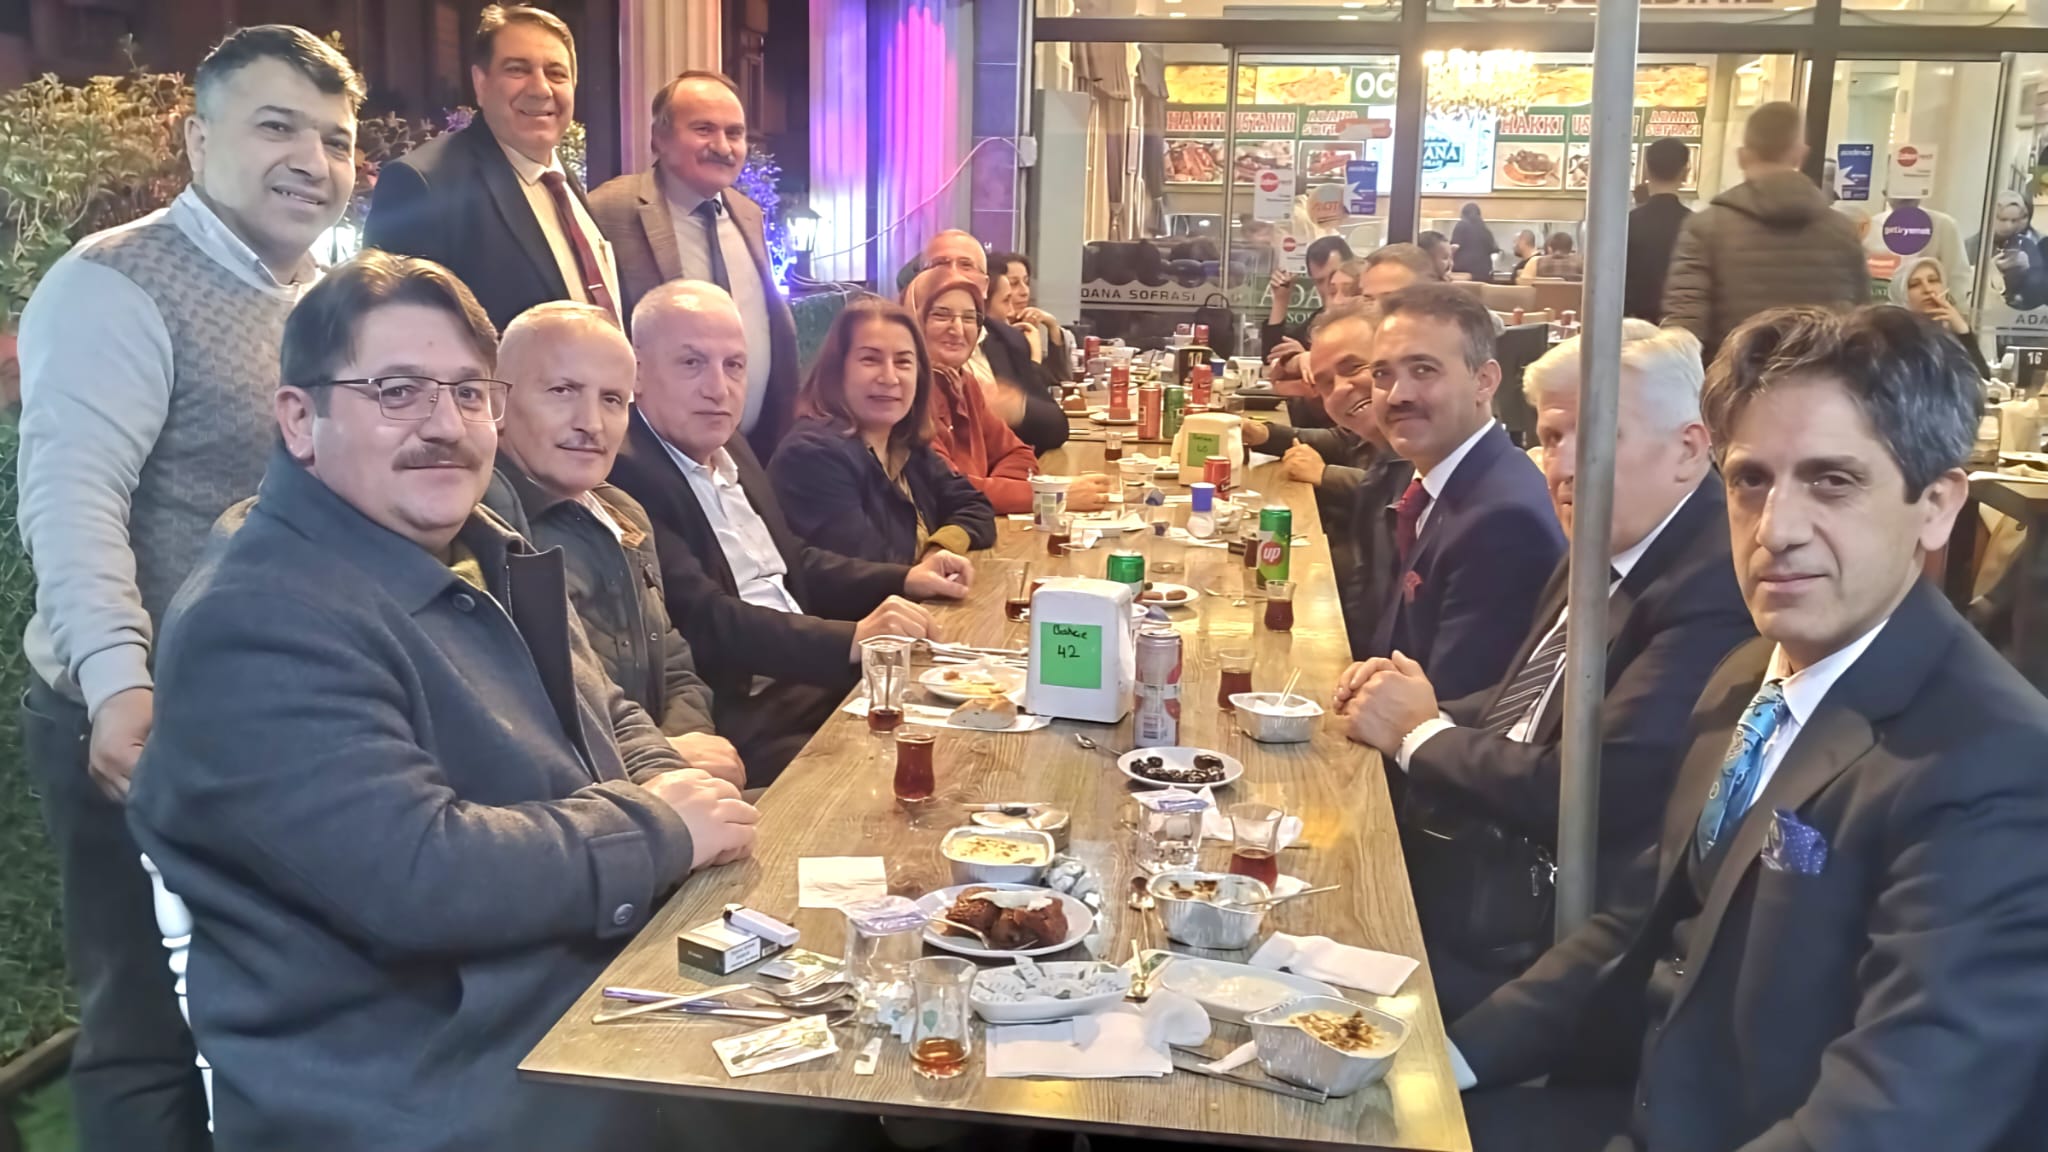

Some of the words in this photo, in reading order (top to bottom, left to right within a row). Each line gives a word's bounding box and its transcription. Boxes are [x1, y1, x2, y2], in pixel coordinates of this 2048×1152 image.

[1650, 110, 1699, 123] ADANA
[1500, 114, 1564, 135] HAKKI
[1129, 289, 1196, 301] SOFRASI
[2027, 352, 2043, 365] 16
[1058, 644, 1081, 659] 42
